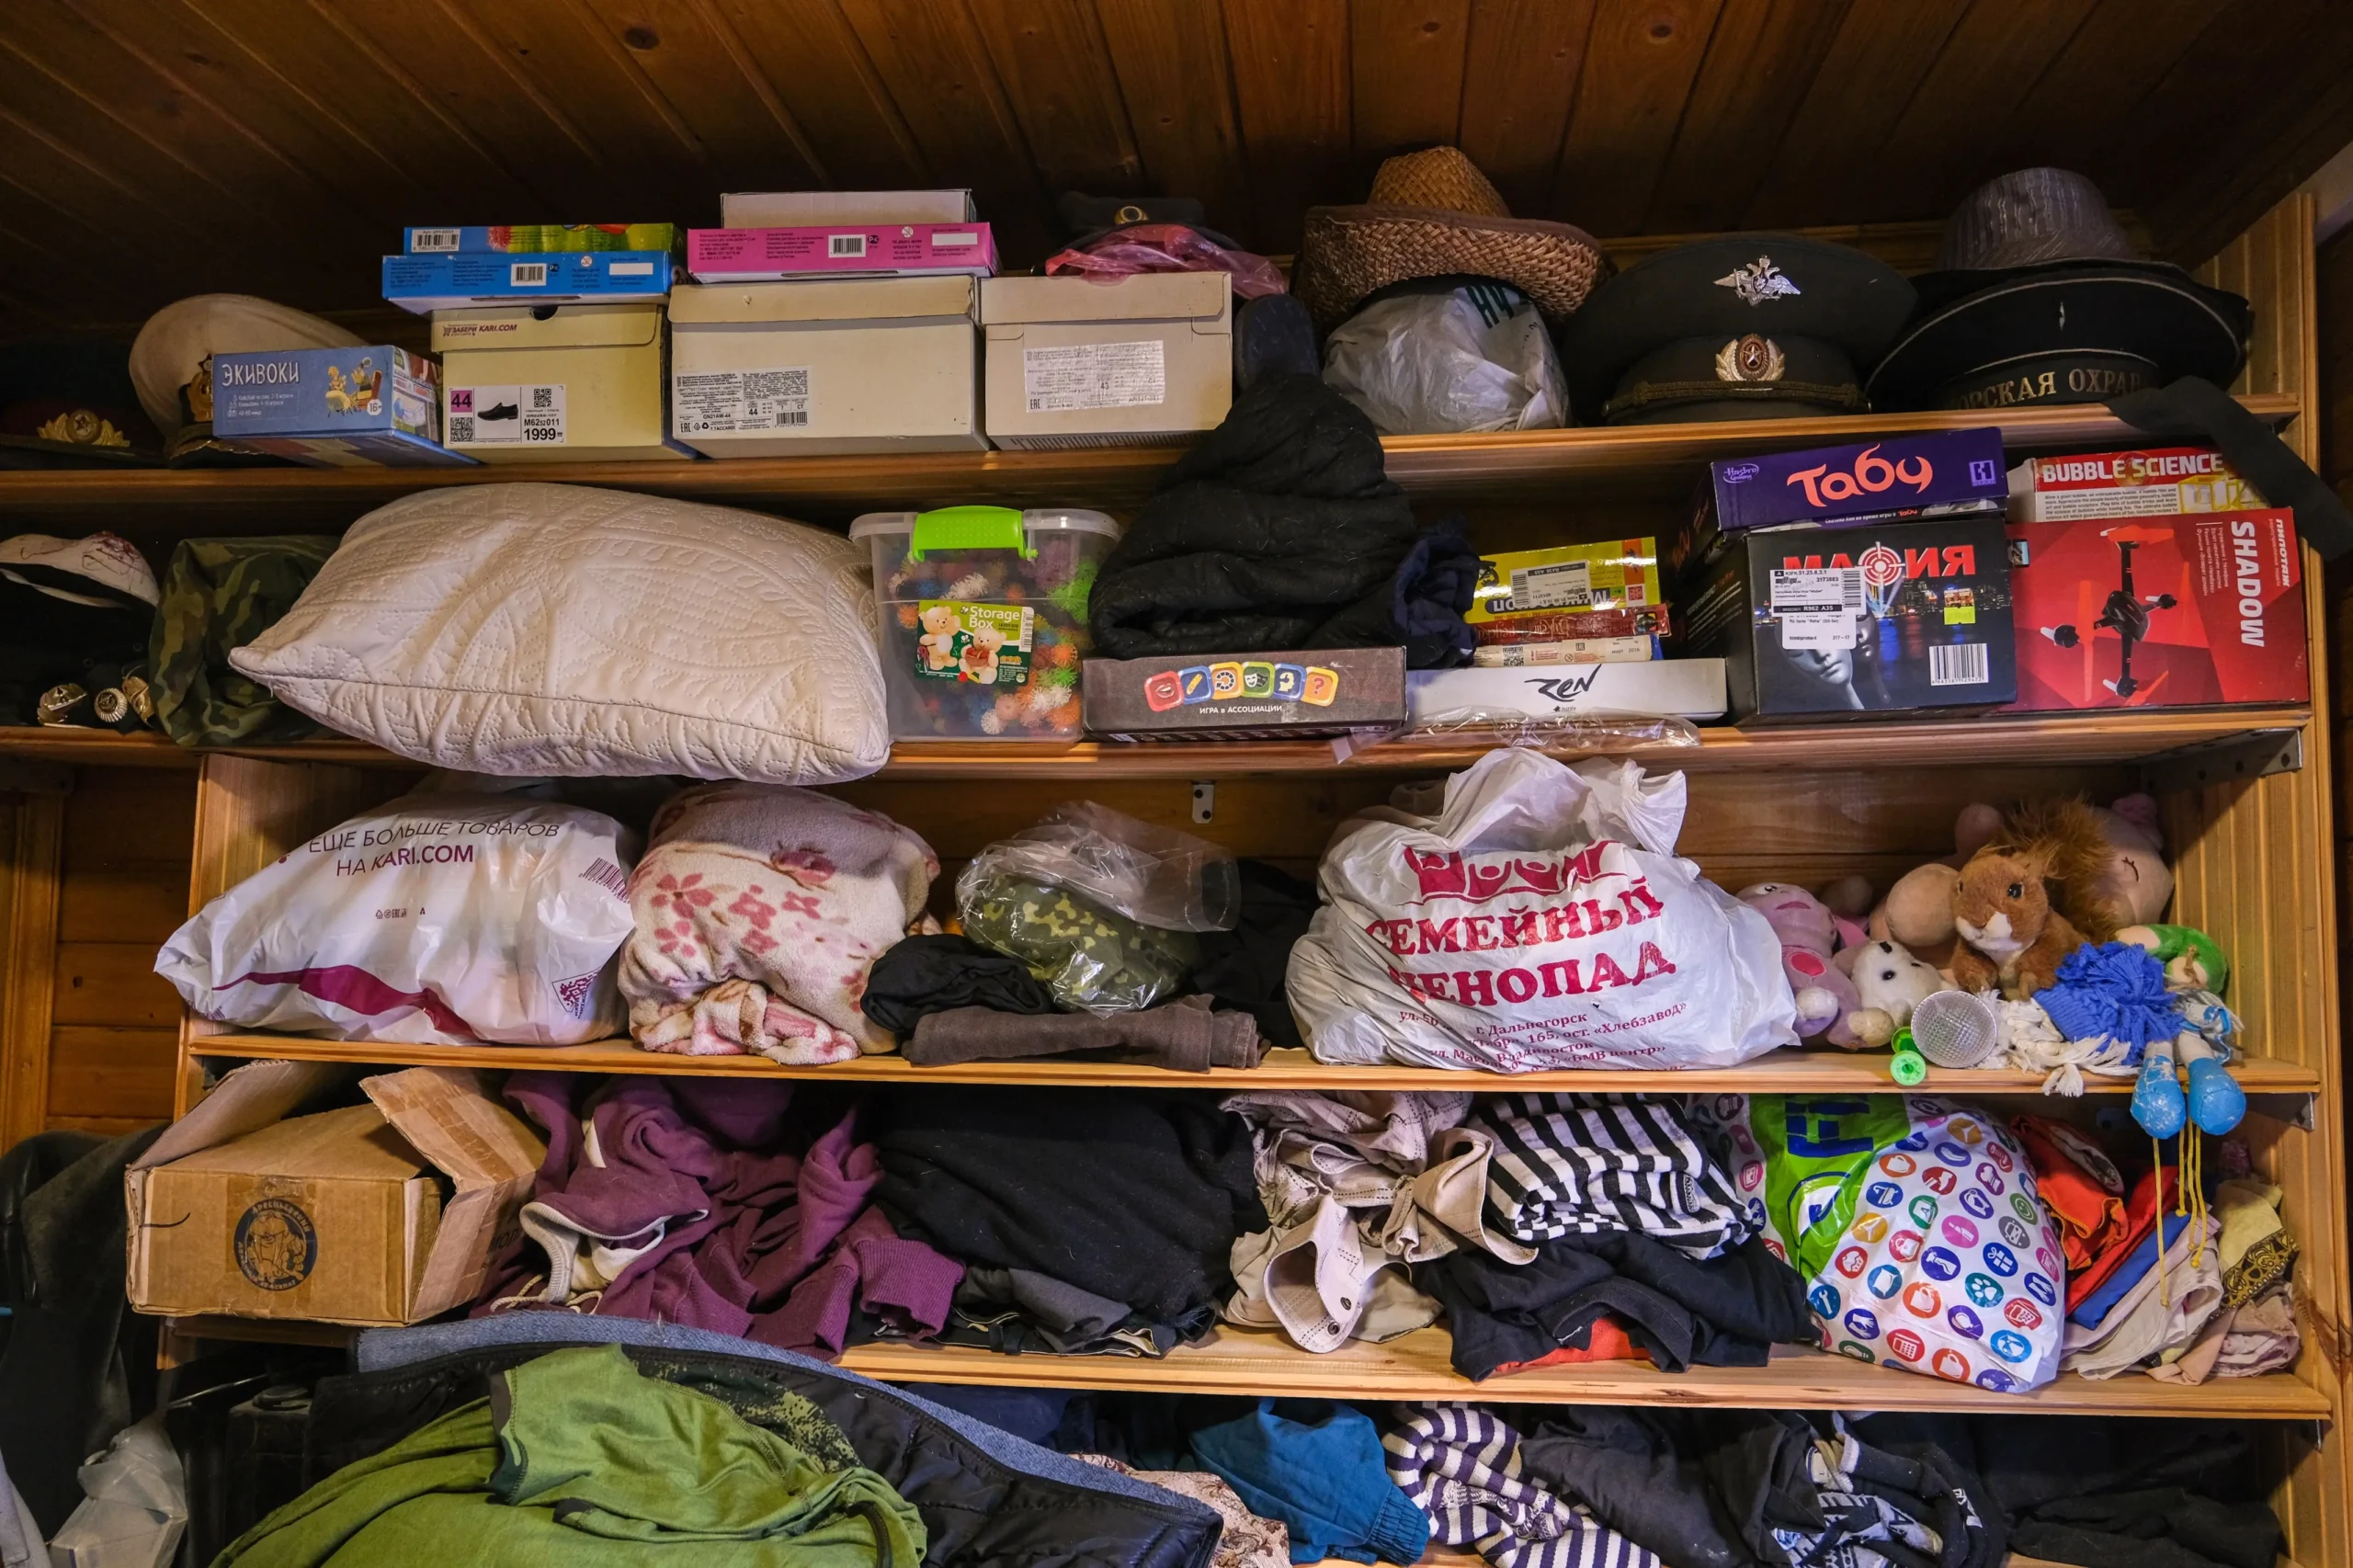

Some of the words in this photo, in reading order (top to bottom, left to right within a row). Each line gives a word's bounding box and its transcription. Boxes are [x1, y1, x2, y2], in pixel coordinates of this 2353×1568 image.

[222, 361, 300, 387] ЭКИВОКИ
[451, 393, 472, 408] 44
[1954, 371, 2057, 410] ОРСКАЯ
[2068, 368, 2149, 394] ОХРАН
[369, 403, 382, 413] 16+
[524, 428, 556, 441] 1999
[1723, 466, 1757, 477] Hasbro
[1787, 442, 1933, 508] Табу
[2042, 460, 2127, 483] BUBBLE
[2131, 453, 2225, 478] SCIENCE
[2275, 518, 2290, 587] ПИЛОТАЖ
[2231, 521, 2265, 648] SHADOW
[969, 618, 994, 629] Box
[970, 606, 1020, 623] Storage
[1199, 706, 1219, 715] ИГРА
[1227, 704, 1283, 714] АССОЦИАЦИИ
[309, 830, 358, 853] ЕЩЕ
[363, 822, 453, 846] БОЛЬШЕ
[458, 821, 560, 838] ТОВАРОВ
[336, 859, 367, 877] НА
[370, 844, 474, 871] KARI.COM
[1399, 1011, 1419, 1023] ул.
[1488, 1012, 1587, 1038] Дальнегорск
[1527, 1029, 1560, 1045] 165,
[1563, 1028, 1591, 1039] ост.
[1594, 1002, 1688, 1035] «Хлебзавод»
